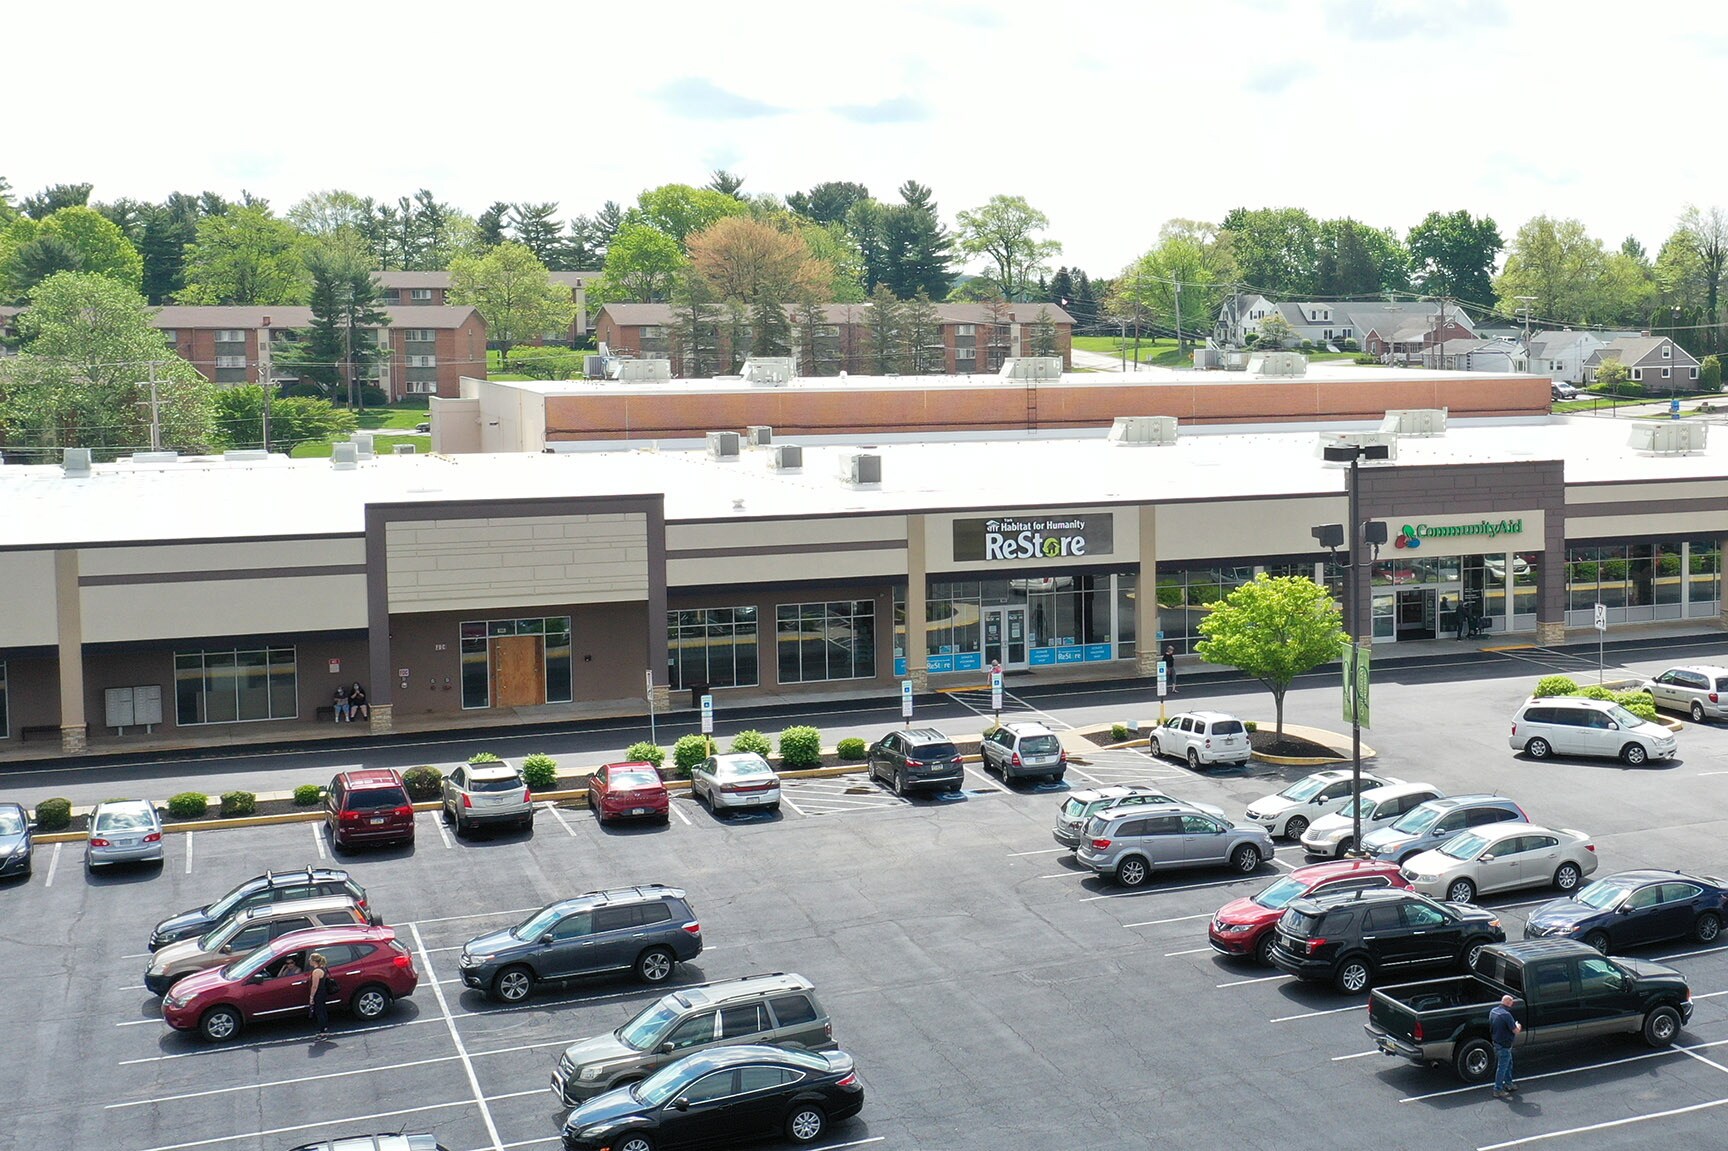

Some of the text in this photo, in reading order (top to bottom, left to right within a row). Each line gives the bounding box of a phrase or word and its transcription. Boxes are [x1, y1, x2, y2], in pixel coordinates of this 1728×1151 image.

[1000, 518, 1086, 532] Habitat for Humanity
[1416, 519, 1523, 538] CommunityAid
[985, 530, 1086, 560] ReStore
[926, 662, 951, 670] ReStre
